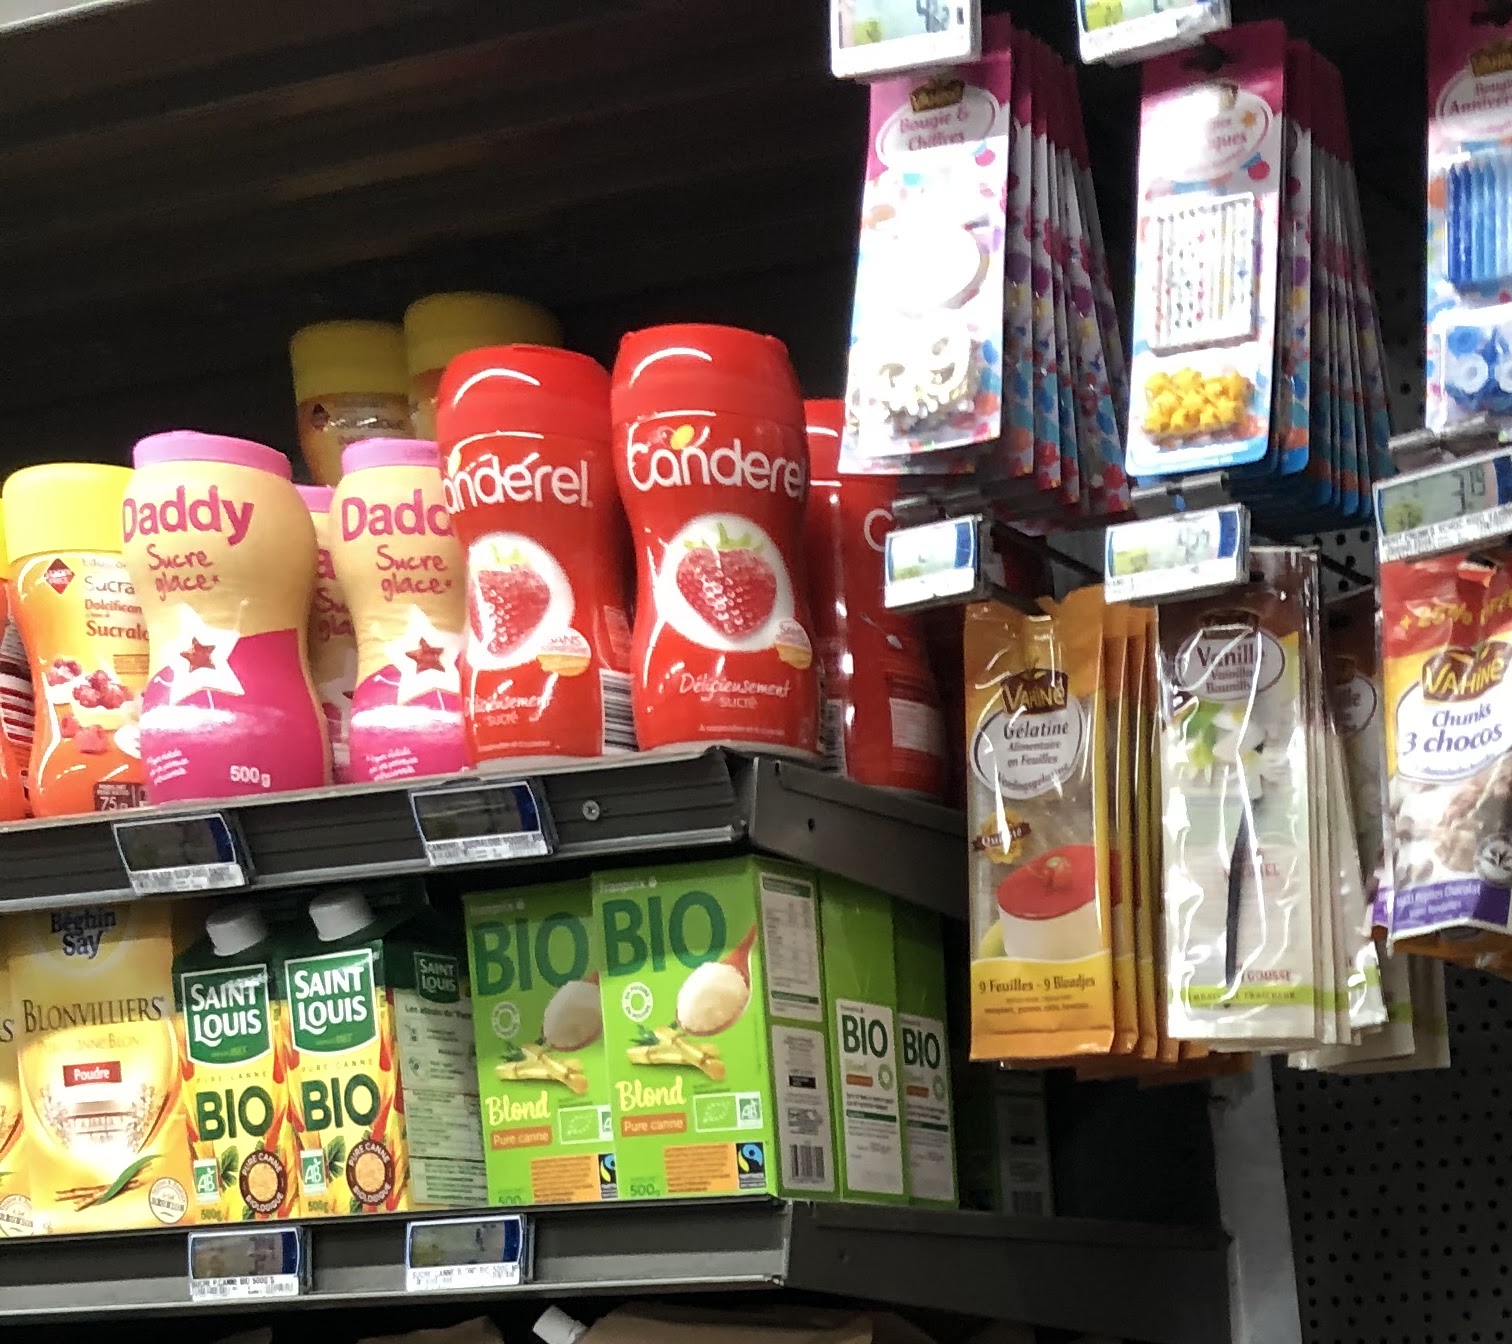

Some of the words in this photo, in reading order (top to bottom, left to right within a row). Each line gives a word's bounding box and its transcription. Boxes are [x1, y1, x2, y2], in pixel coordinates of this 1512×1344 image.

[122, 484, 256, 546] Daddy
[146, 543, 214, 573] Sucre
[375, 543, 448, 573] Sucre
[1424, 658, 1504, 696] VAHINÉ
[1003, 718, 1070, 741] Gélatine
[1431, 704, 1492, 729] Chunks
[1404, 733, 1417, 754] 3
[1422, 725, 1504, 754] chocos
[601, 890, 728, 978] BIO
[418, 957, 458, 982] SAINT
[472, 911, 589, 998] BIO
[189, 978, 260, 1012] SAINT
[294, 964, 368, 999] SAINT
[420, 972, 458, 994] LOUIS
[194, 1009, 263, 1047] LOUIS
[298, 994, 368, 1036] LOUIS
[840, 1013, 889, 1059] BIO
[901, 1027, 942, 1070] BIO
[72, 1065, 111, 1083] Poudre
[300, 1072, 381, 1133] BIO
[485, 1091, 550, 1128] Blond
[614, 1075, 686, 1113] Blond
[195, 1084, 274, 1143] BIO
[623, 1117, 649, 1134] Pure
[650, 1115, 686, 1131] canne
[493, 1131, 515, 1147] Pure
[516, 1128, 550, 1145] canne
